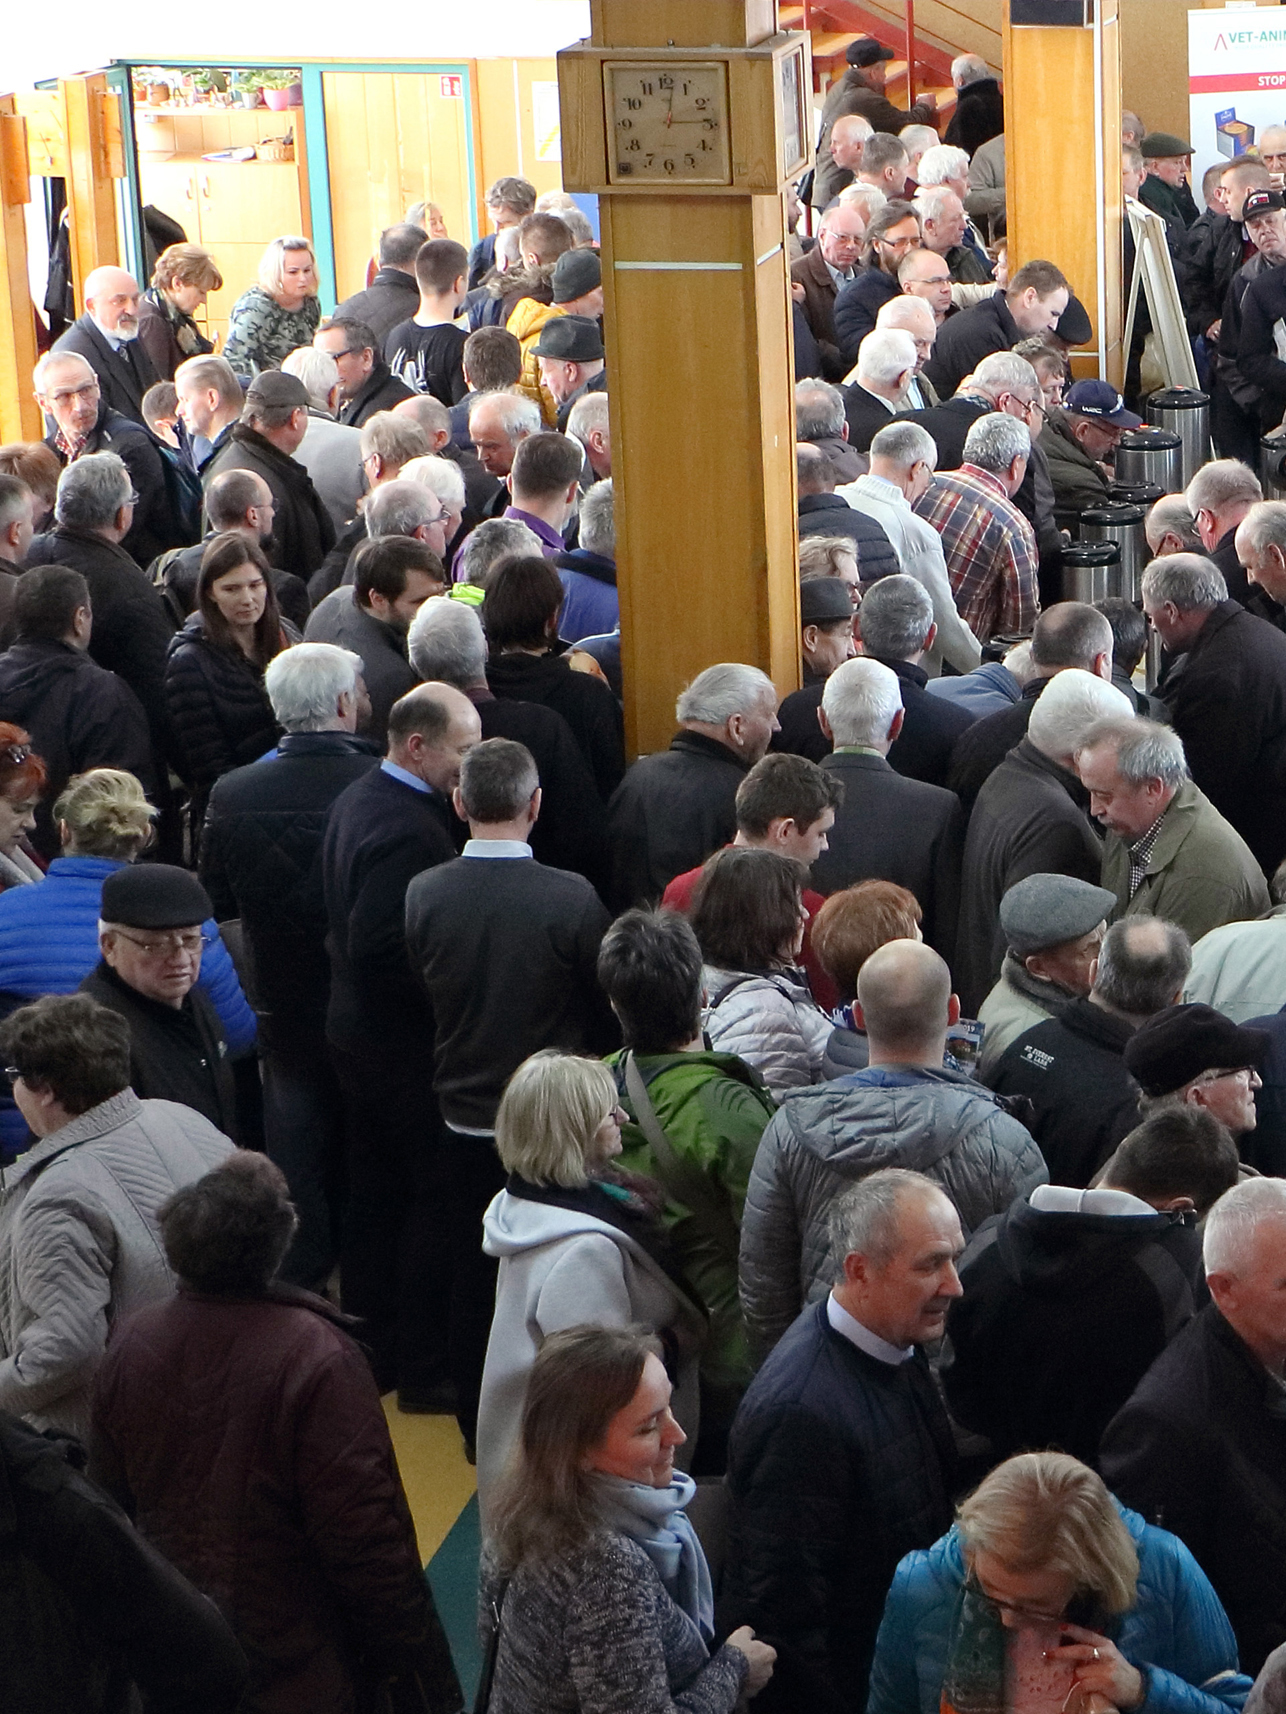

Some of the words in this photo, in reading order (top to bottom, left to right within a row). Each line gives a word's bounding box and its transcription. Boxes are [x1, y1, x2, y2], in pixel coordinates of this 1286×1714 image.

[659, 76, 674, 90] 12
[1258, 75, 1286, 87] STOP
[642, 83, 653, 95] 11
[683, 83, 688, 95] 1
[626, 98, 642, 110] 10
[695, 98, 706, 110] 2
[621, 118, 632, 131] 9
[702, 118, 714, 131] 3
[629, 139, 640, 151] 8
[696, 139, 706, 151] 4
[645, 153, 655, 166] 7
[663, 159, 675, 171] 6
[684, 153, 696, 166] 5
